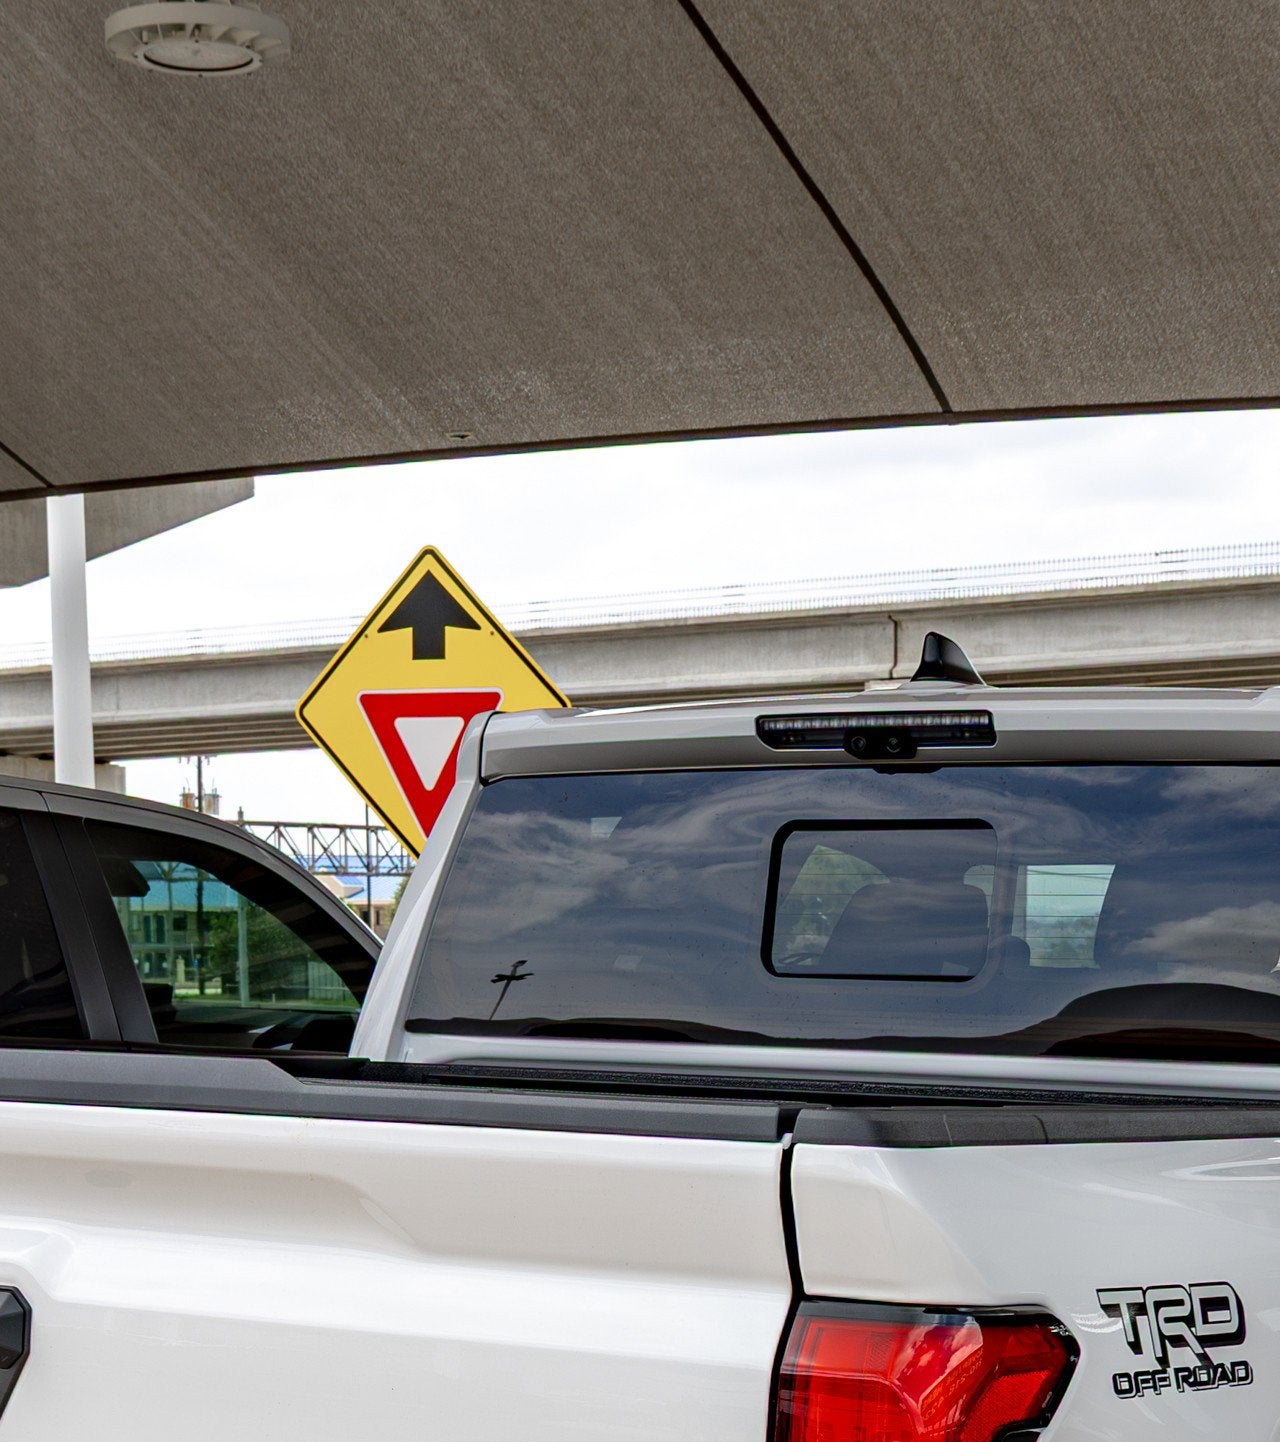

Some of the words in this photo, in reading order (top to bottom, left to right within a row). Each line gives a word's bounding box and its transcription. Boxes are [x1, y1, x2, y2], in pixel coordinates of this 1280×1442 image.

[1096, 1281, 1246, 1369] TRD
[1112, 1369, 1171, 1399] OFF
[1174, 1360, 1254, 1393] ROAD
